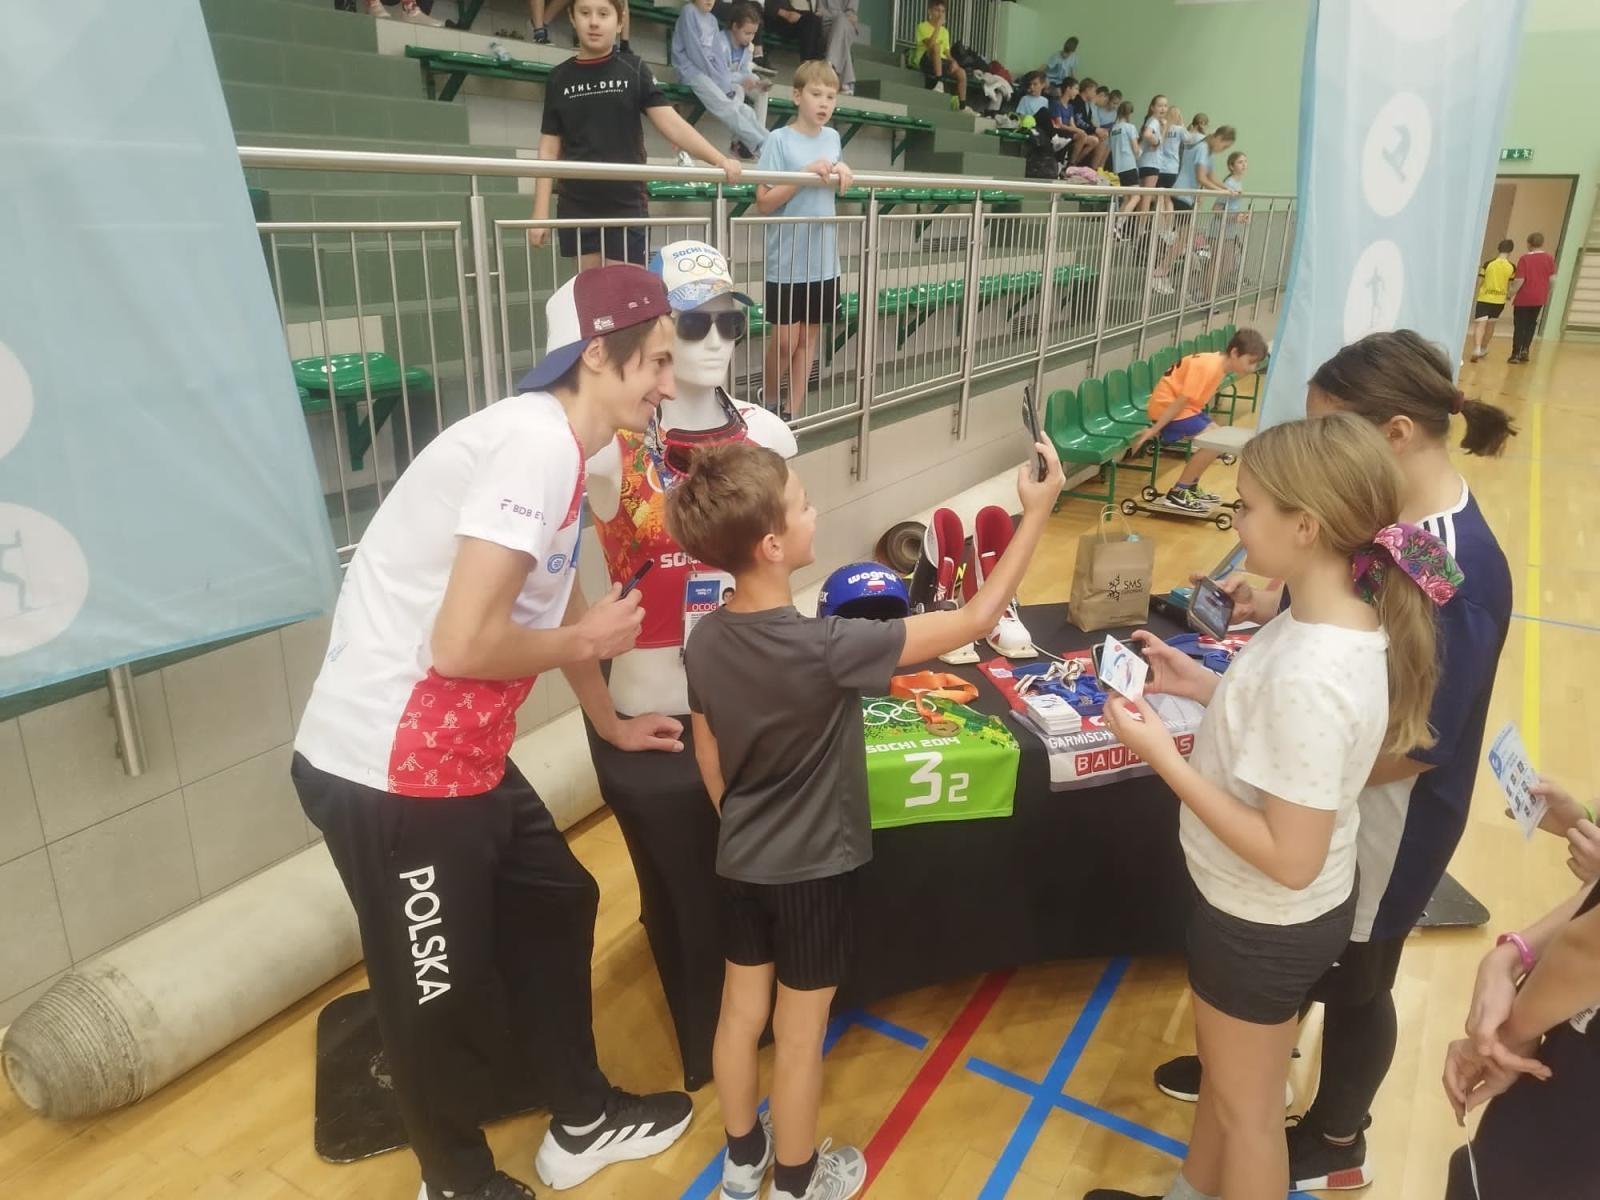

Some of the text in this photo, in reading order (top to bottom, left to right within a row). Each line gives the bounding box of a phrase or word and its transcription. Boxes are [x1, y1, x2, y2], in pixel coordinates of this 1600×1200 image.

[564, 80, 628, 95] ATHL-DEPT
[672, 247, 703, 259] SOCHI
[512, 504, 533, 517] BDB
[1123, 578, 1142, 590] SMS
[692, 603, 717, 611] OCOG
[865, 736, 961, 753] SOCHI 2014
[1048, 730, 1116, 749] GARMISCH
[1076, 735, 1193, 773] BAUHS
[904, 752, 969, 807] 3 2
[399, 865, 451, 1005] POLSKA
